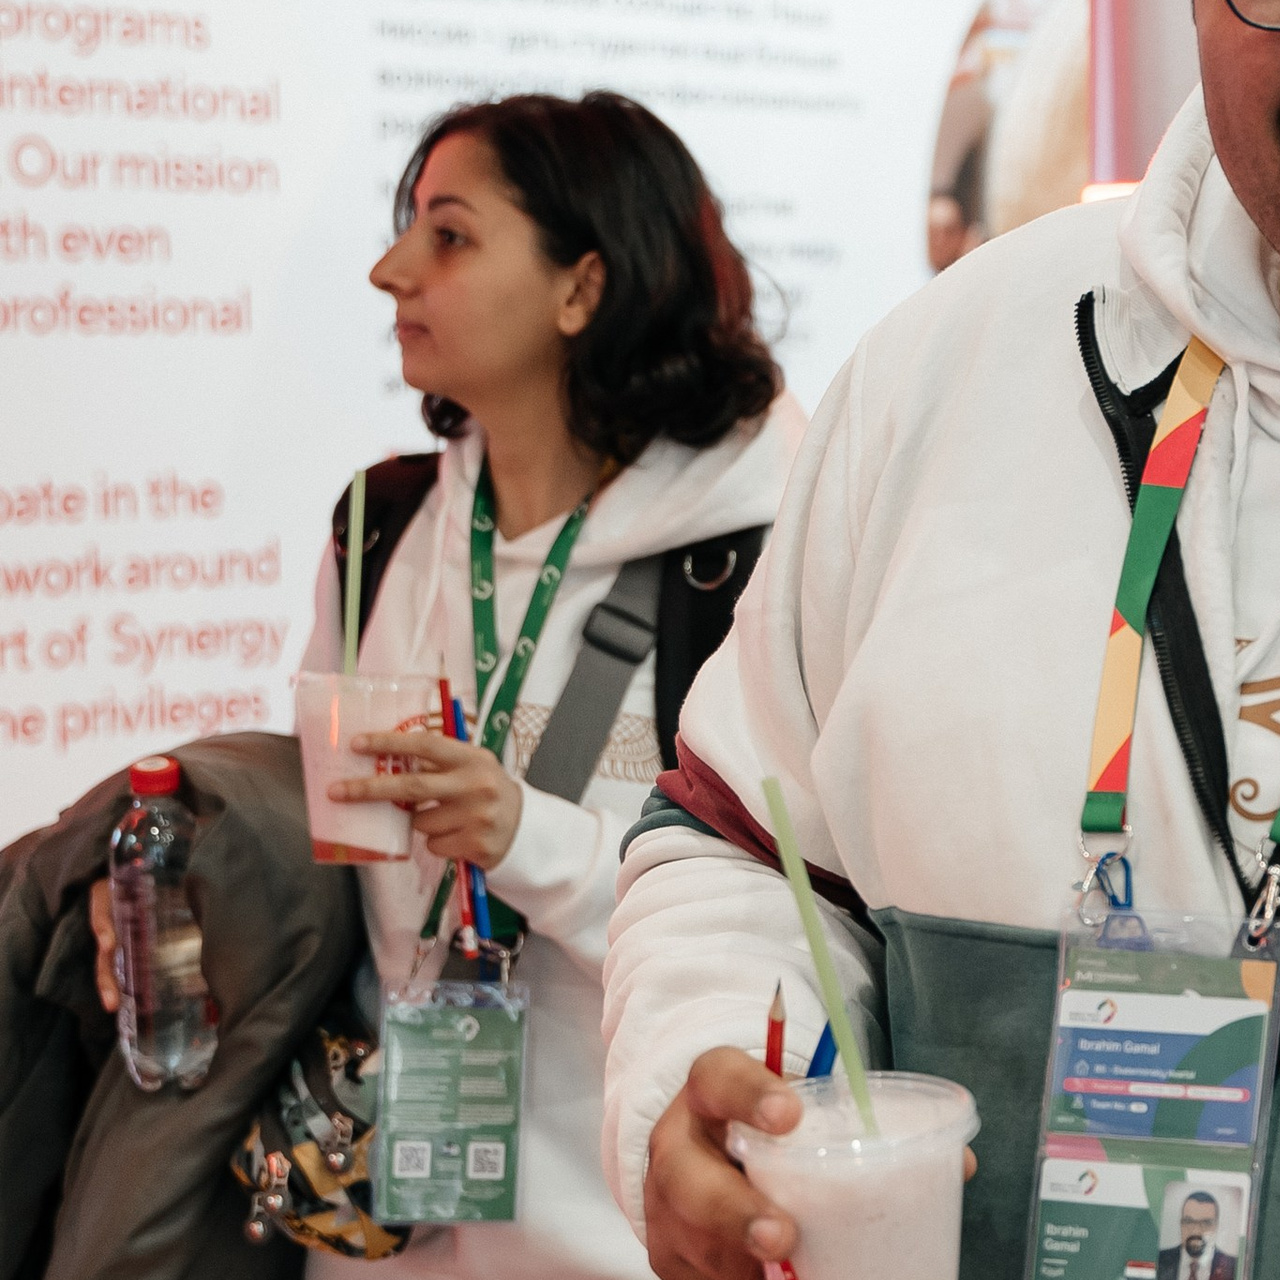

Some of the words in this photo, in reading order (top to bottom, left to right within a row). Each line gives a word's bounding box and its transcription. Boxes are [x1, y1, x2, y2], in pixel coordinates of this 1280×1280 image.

[8, 131, 102, 190] Our
[110, 140, 281, 195] mission
[56, 223, 174, 264] even
[95, 470, 139, 520] in
[146, 469, 225, 520] the
[2, 540, 113, 597] work
[124, 533, 281, 590] around
[40, 614, 90, 672] of
[106, 608, 290, 677] Synergy
